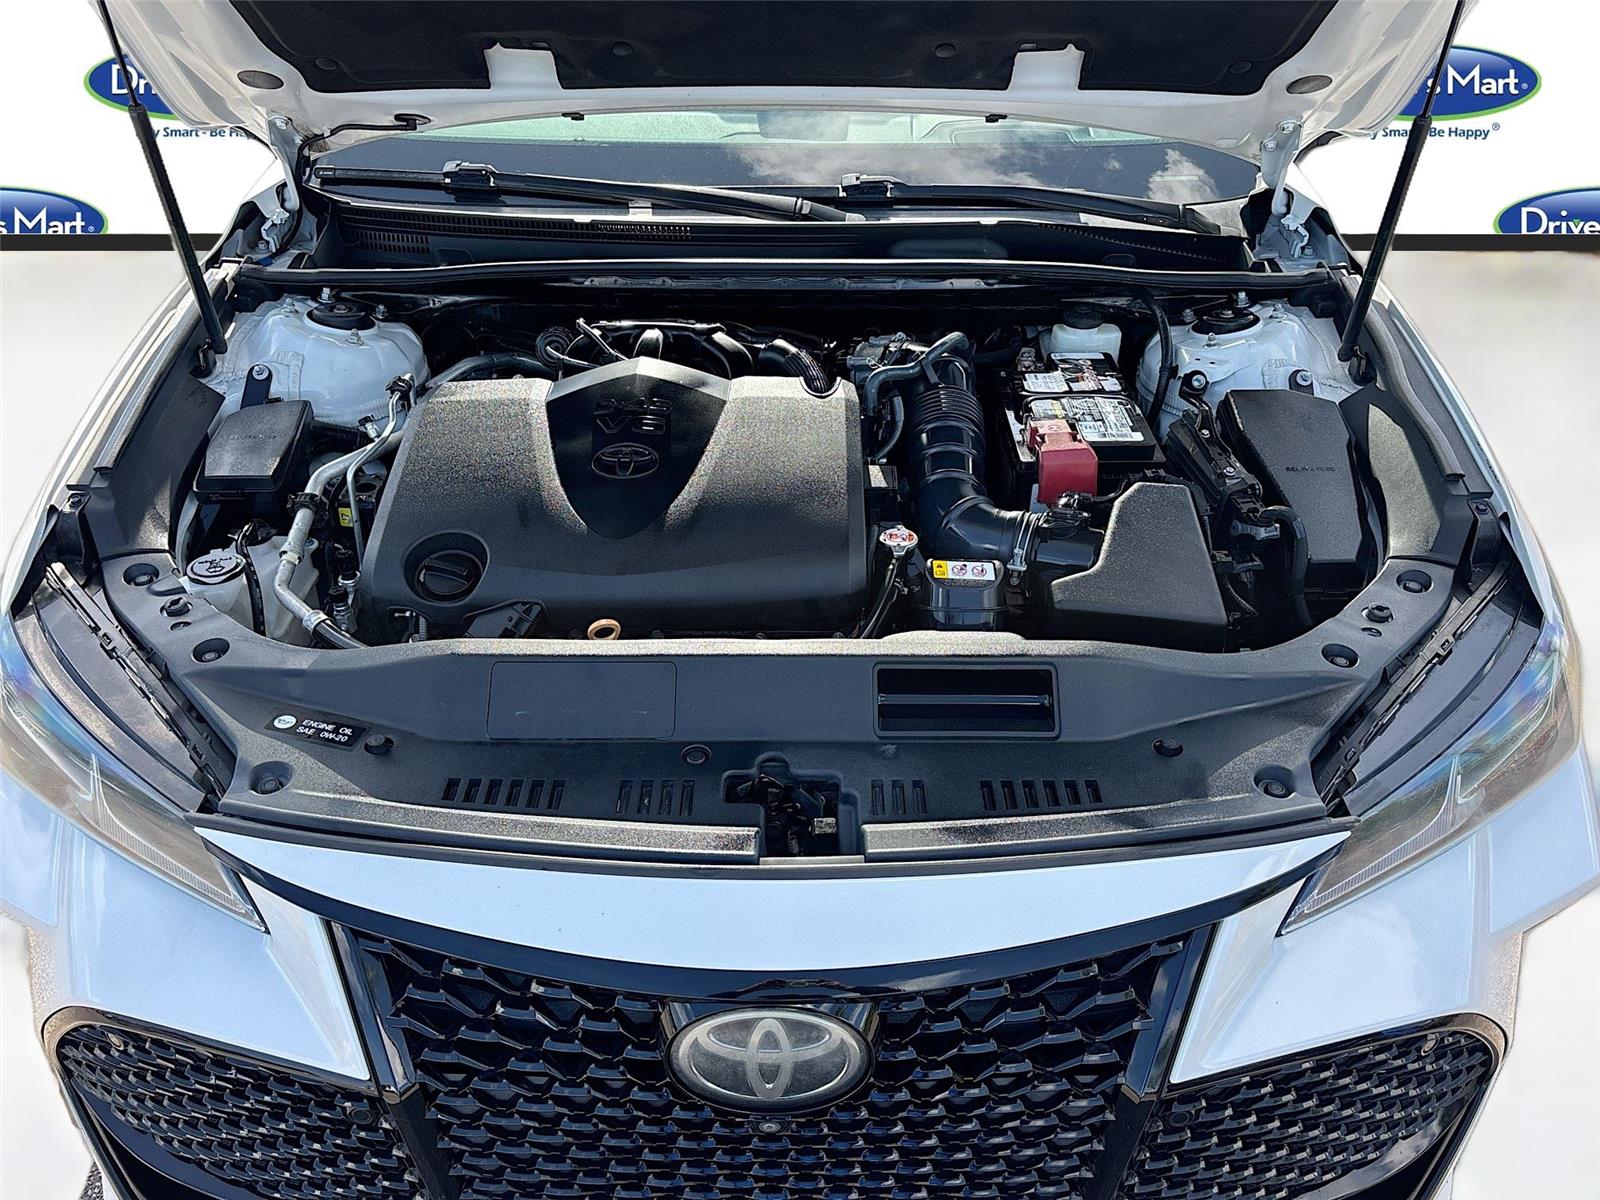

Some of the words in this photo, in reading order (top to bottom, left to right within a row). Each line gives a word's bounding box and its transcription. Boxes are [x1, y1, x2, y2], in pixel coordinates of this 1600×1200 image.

[1447, 64, 1519, 94] Mart
[163, 127, 200, 137] Smart
[1382, 127, 1409, 137] Sma
[1429, 127, 1445, 137] Be
[1448, 127, 1490, 140] Happy
[14, 206, 85, 234] Mart
[296, 726, 317, 735] SAE
[320, 731, 349, 742] 0W-20
[302, 719, 337, 732] ENGINE
[339, 727, 353, 736] OIL
